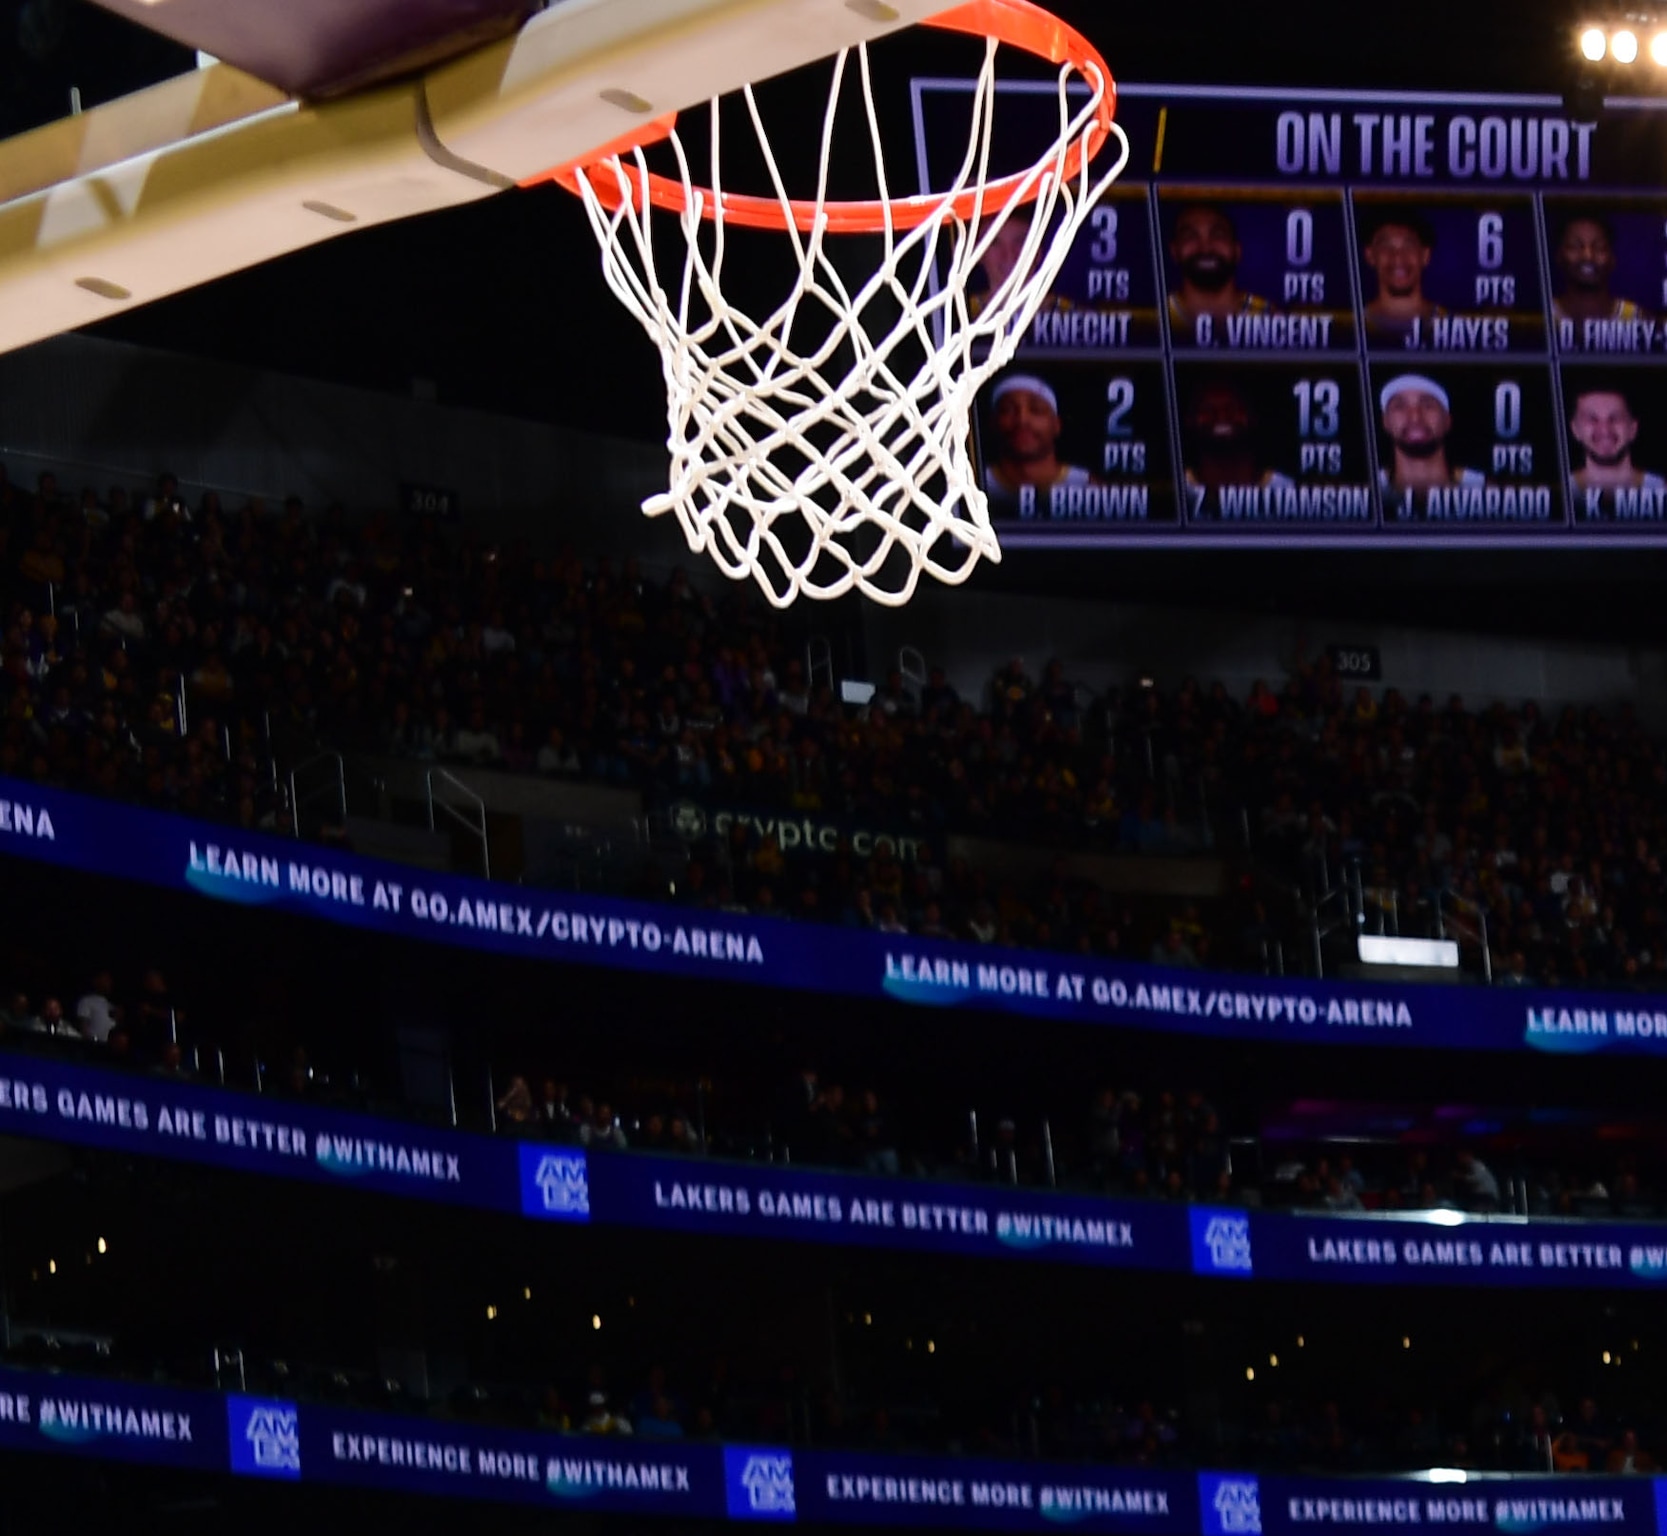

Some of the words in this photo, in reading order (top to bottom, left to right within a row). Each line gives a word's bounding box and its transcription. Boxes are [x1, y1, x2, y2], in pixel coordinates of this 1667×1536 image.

[1277, 112, 1341, 171] ON
[1354, 114, 1434, 173] THE
[1449, 116, 1597, 177] COURT
[1092, 206, 1117, 259] 3
[1287, 209, 1312, 262] 0
[1479, 213, 1502, 265] 6
[1089, 270, 1129, 297] PTS
[1285, 273, 1324, 300] PTS
[1476, 276, 1514, 303] PTS
[1034, 312, 1131, 347] KNECHT
[1225, 314, 1333, 349] VINCENT
[1433, 319, 1508, 350] HAYES
[1107, 380, 1135, 437] 2
[1293, 380, 1340, 437] 13
[1496, 382, 1520, 437] 0
[1105, 443, 1145, 468] PTS
[1301, 444, 1341, 469] PTS
[1493, 445, 1532, 470] PTS
[1050, 486, 1148, 518] BROWN
[1219, 487, 1369, 520] WILLIAMSON
[1423, 487, 1550, 520] ALVARADO
[1337, 650, 1372, 674] 305
[190, 842, 279, 885] LEARN
[289, 863, 364, 904] MORE
[374, 882, 401, 911] AT
[411, 882, 763, 962] GO.AMEX/CRYPTO-ARENA
[333, 1433, 469, 1471] EXPERIENCE
[479, 1451, 537, 1479] MORE
[547, 1459, 688, 1489] #WITHAMEX
